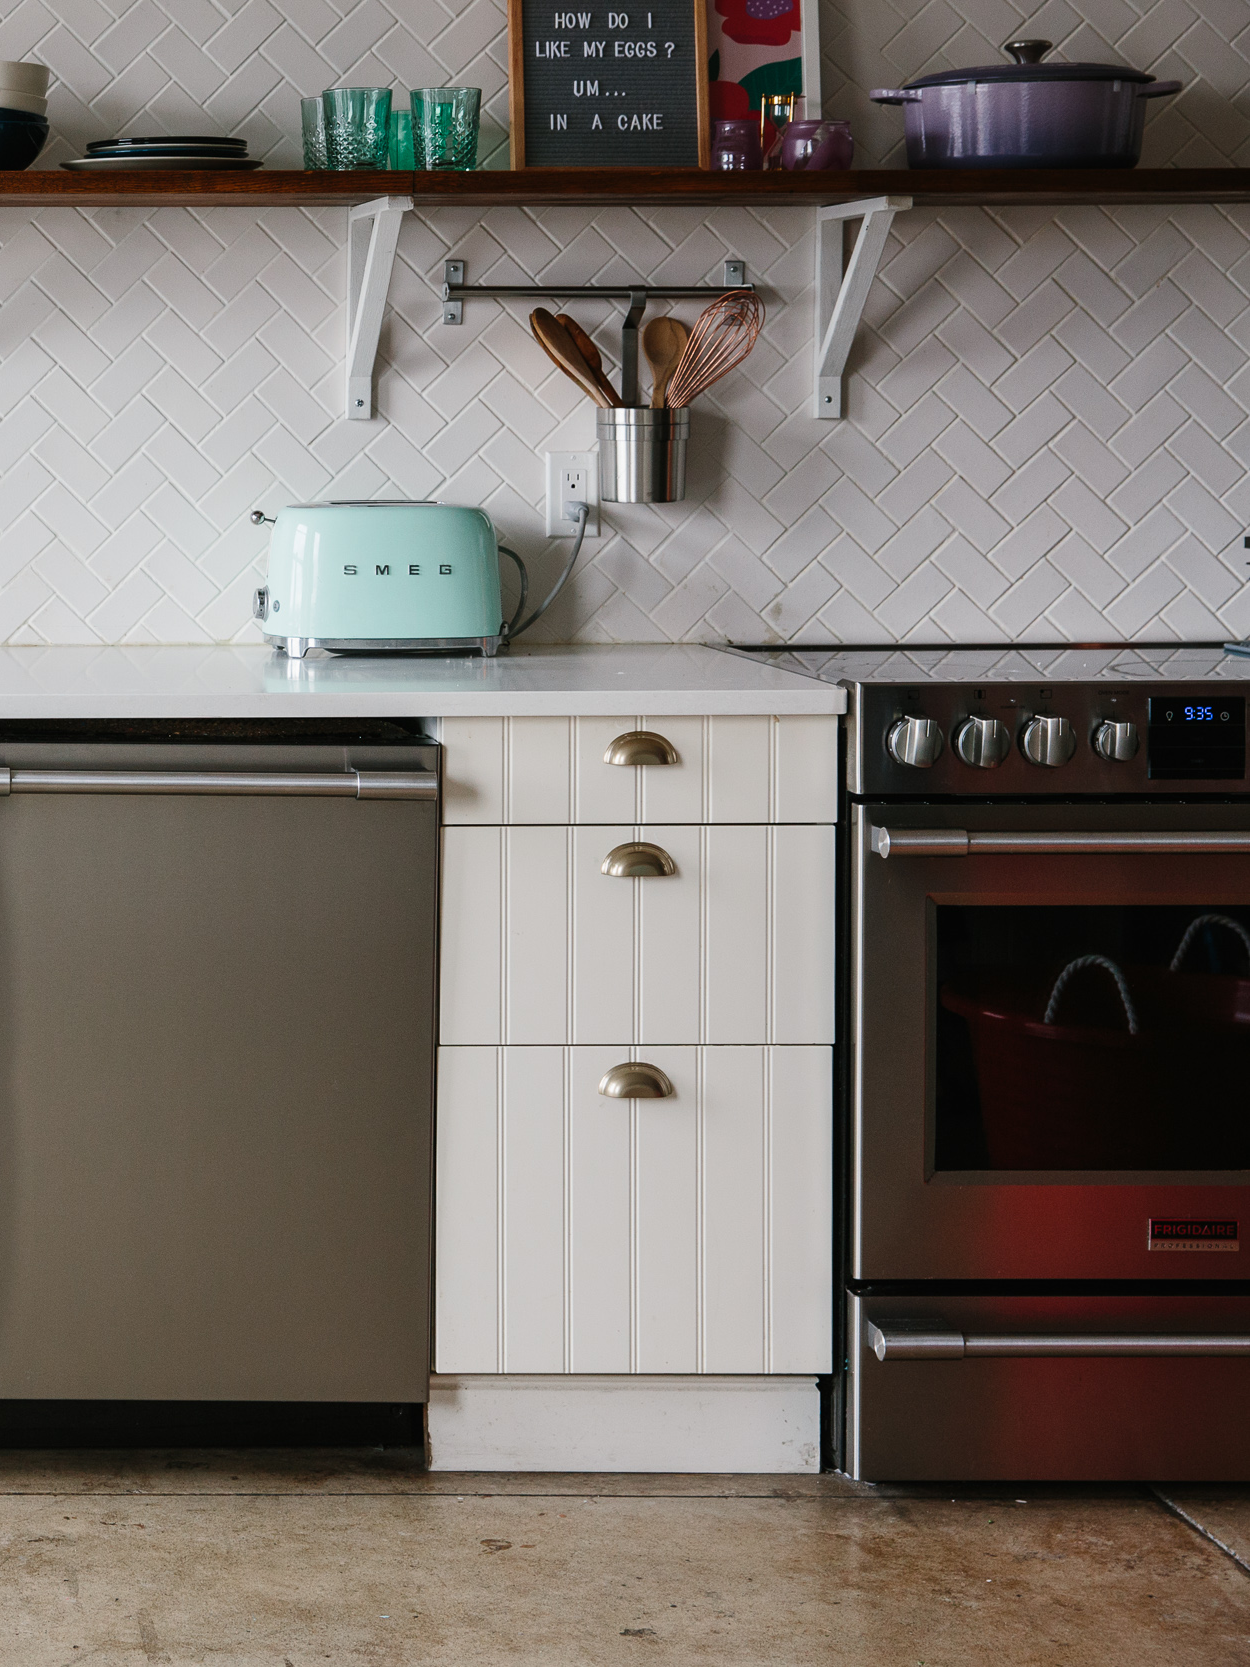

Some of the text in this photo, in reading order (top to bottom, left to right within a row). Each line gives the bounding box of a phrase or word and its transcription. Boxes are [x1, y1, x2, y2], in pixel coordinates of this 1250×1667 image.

[554, 12, 652, 29] HOW DO I
[536, 41, 570, 59] LIKE
[583, 41, 606, 58] MY
[573, 80, 627, 98] UM...
[550, 114, 664, 131] IN A CAKE
[343, 564, 453, 576] SMEG
[1184, 706, 1214, 721] 9:35
[1154, 1225, 1234, 1236] FRIGIDAIRE
